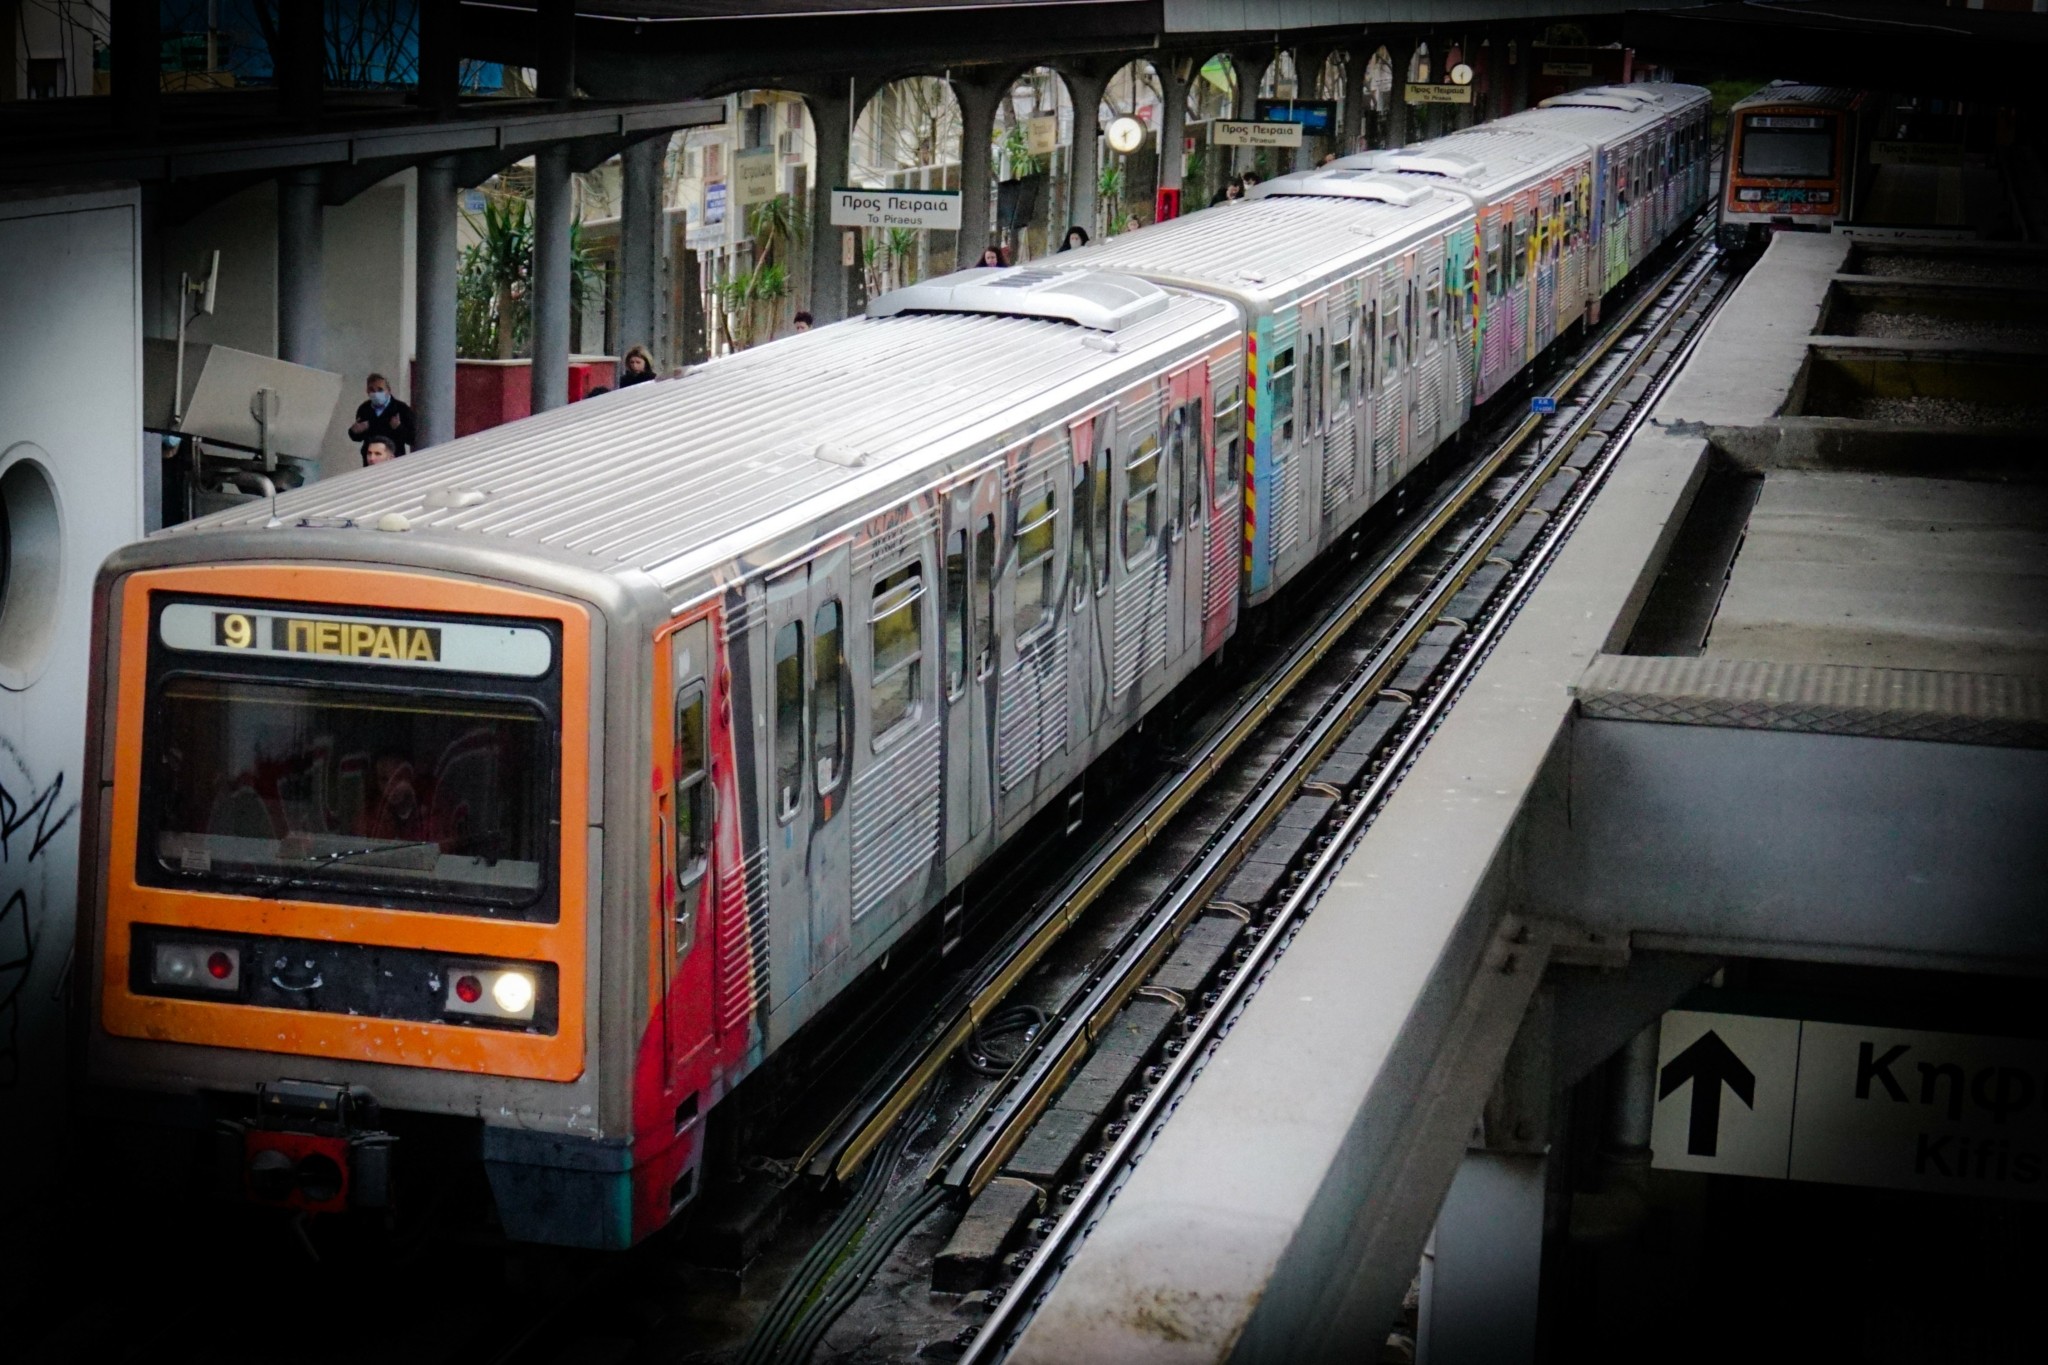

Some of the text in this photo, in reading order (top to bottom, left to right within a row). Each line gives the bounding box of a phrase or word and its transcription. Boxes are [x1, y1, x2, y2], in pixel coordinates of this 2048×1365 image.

[1222, 124, 1294, 136] Προς Πειραιά
[1250, 136, 1277, 144] Piraeus
[1879, 142, 1908, 154] Προς
[842, 195, 948, 213] Προς Πειραιά
[867, 213, 923, 225] To Piraeus
[223, 614, 435, 662] 9 ΠΕΙΡΑΙΑ
[1915, 1133, 2048, 1184] Kifis
